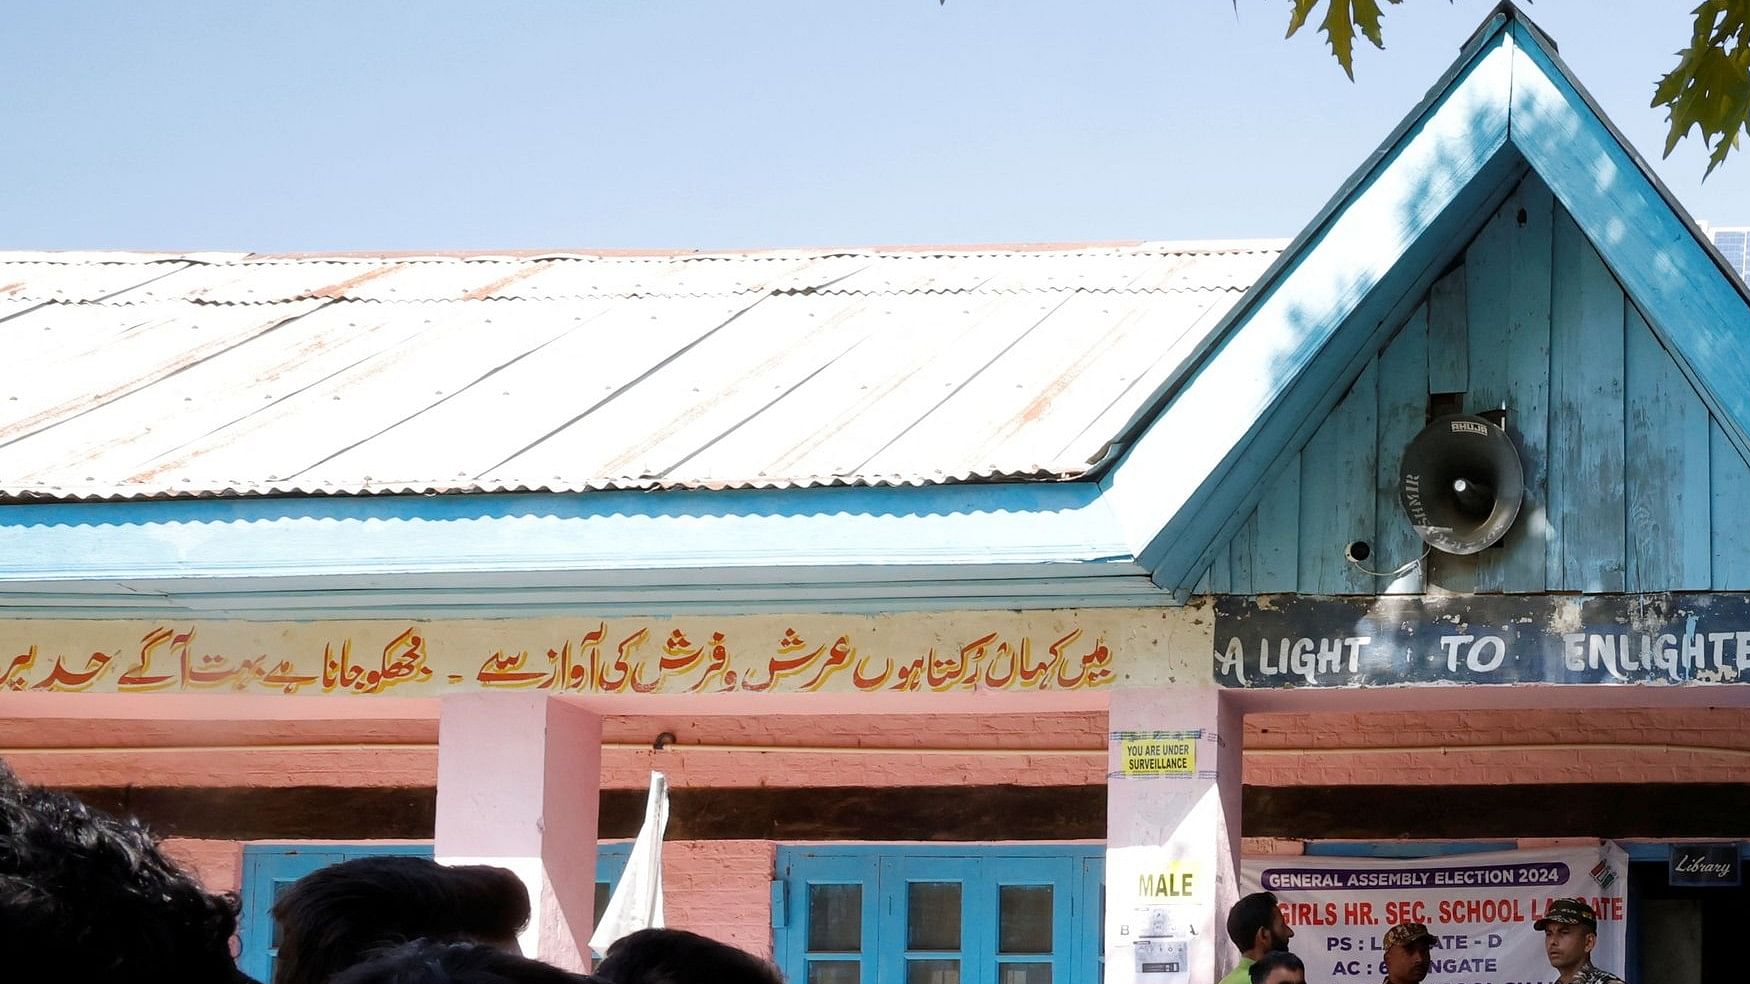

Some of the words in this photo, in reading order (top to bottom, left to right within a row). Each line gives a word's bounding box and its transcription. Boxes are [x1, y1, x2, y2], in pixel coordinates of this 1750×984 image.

[1450, 421, 1489, 437] AHUJA
[476, 650, 549, 687] سے
[537, 620, 607, 691] آواز
[600, 626, 649, 692] کی
[630, 628, 730, 693] فرش
[742, 627, 857, 692] عرش
[1057, 638, 1116, 690] میں
[1213, 635, 1246, 684] A
[1258, 635, 1372, 685] LIGHT
[1440, 633, 1506, 673] TO
[853, 654, 927, 692] ہوں
[1127, 744, 1144, 756] YOU
[1145, 744, 1161, 756] ARE
[1162, 743, 1189, 756] UNDER
[1128, 757, 1188, 770] SURVEILLANCE
[1269, 873, 1343, 888] GENERAL
[1347, 872, 1430, 887] ASSEMBLY
[1434, 869, 1514, 885] ELECTION
[1518, 867, 1559, 883] 2024
[1675, 854, 1731, 878] Library
[1138, 873, 1193, 897] MALE
[1278, 902, 1338, 926] GIRLS
[1344, 902, 1379, 926] HR.
[1385, 900, 1432, 926] SEC.
[1439, 898, 1525, 924] SCHOOL
[1327, 936, 1352, 951] PS
[1332, 960, 1361, 976] AC
[1428, 958, 1497, 974] NGATE
